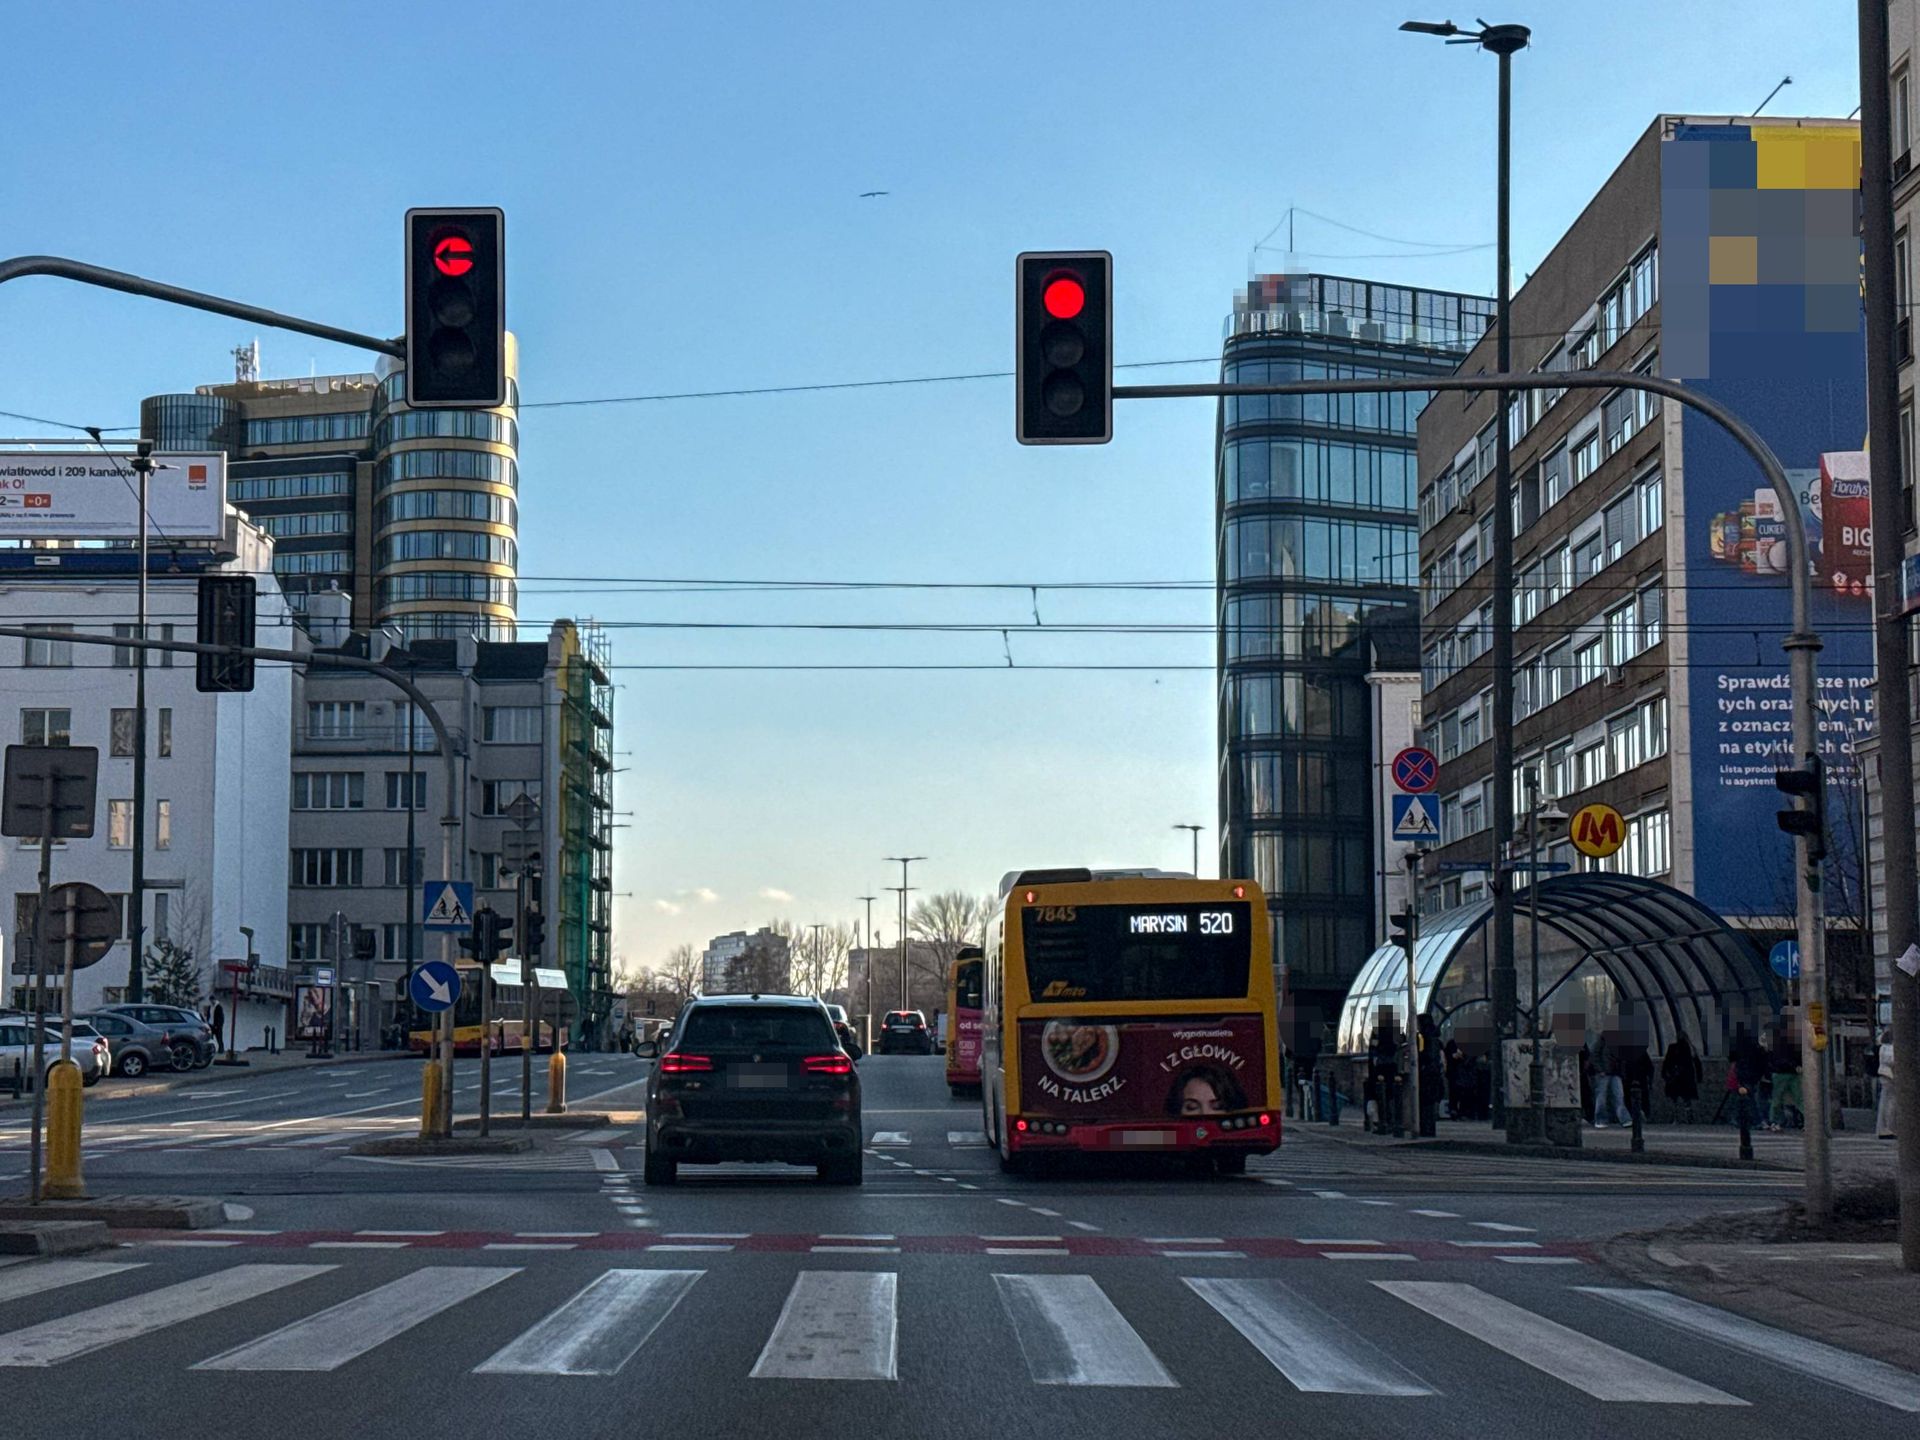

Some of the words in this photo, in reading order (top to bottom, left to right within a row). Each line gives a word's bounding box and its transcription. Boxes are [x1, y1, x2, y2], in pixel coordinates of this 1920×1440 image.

[0, 466, 55, 477] wiatłowód
[58, 466, 62, 476] i
[65, 466, 86, 477] 209
[89, 466, 136, 477] kanałów
[12, 479, 25, 489] O!
[1801, 490, 1820, 505] Be
[1718, 674, 1790, 692] Sprawdź
[1817, 677, 1843, 689] sze
[1718, 696, 1756, 713] tych
[1817, 696, 1860, 713] nych
[1719, 721, 1728, 732] z
[1719, 743, 1740, 754] na
[1719, 764, 1743, 773] Lista
[1744, 764, 1793, 775] produktó
[1733, 777, 1776, 787] asystent
[1034, 907, 1077, 922] 7845
[1130, 915, 1188, 933] MARYSIN
[1199, 912, 1233, 934] 520
[1166, 1051, 1182, 1067] Z
[1037, 1074, 1059, 1098] NA
